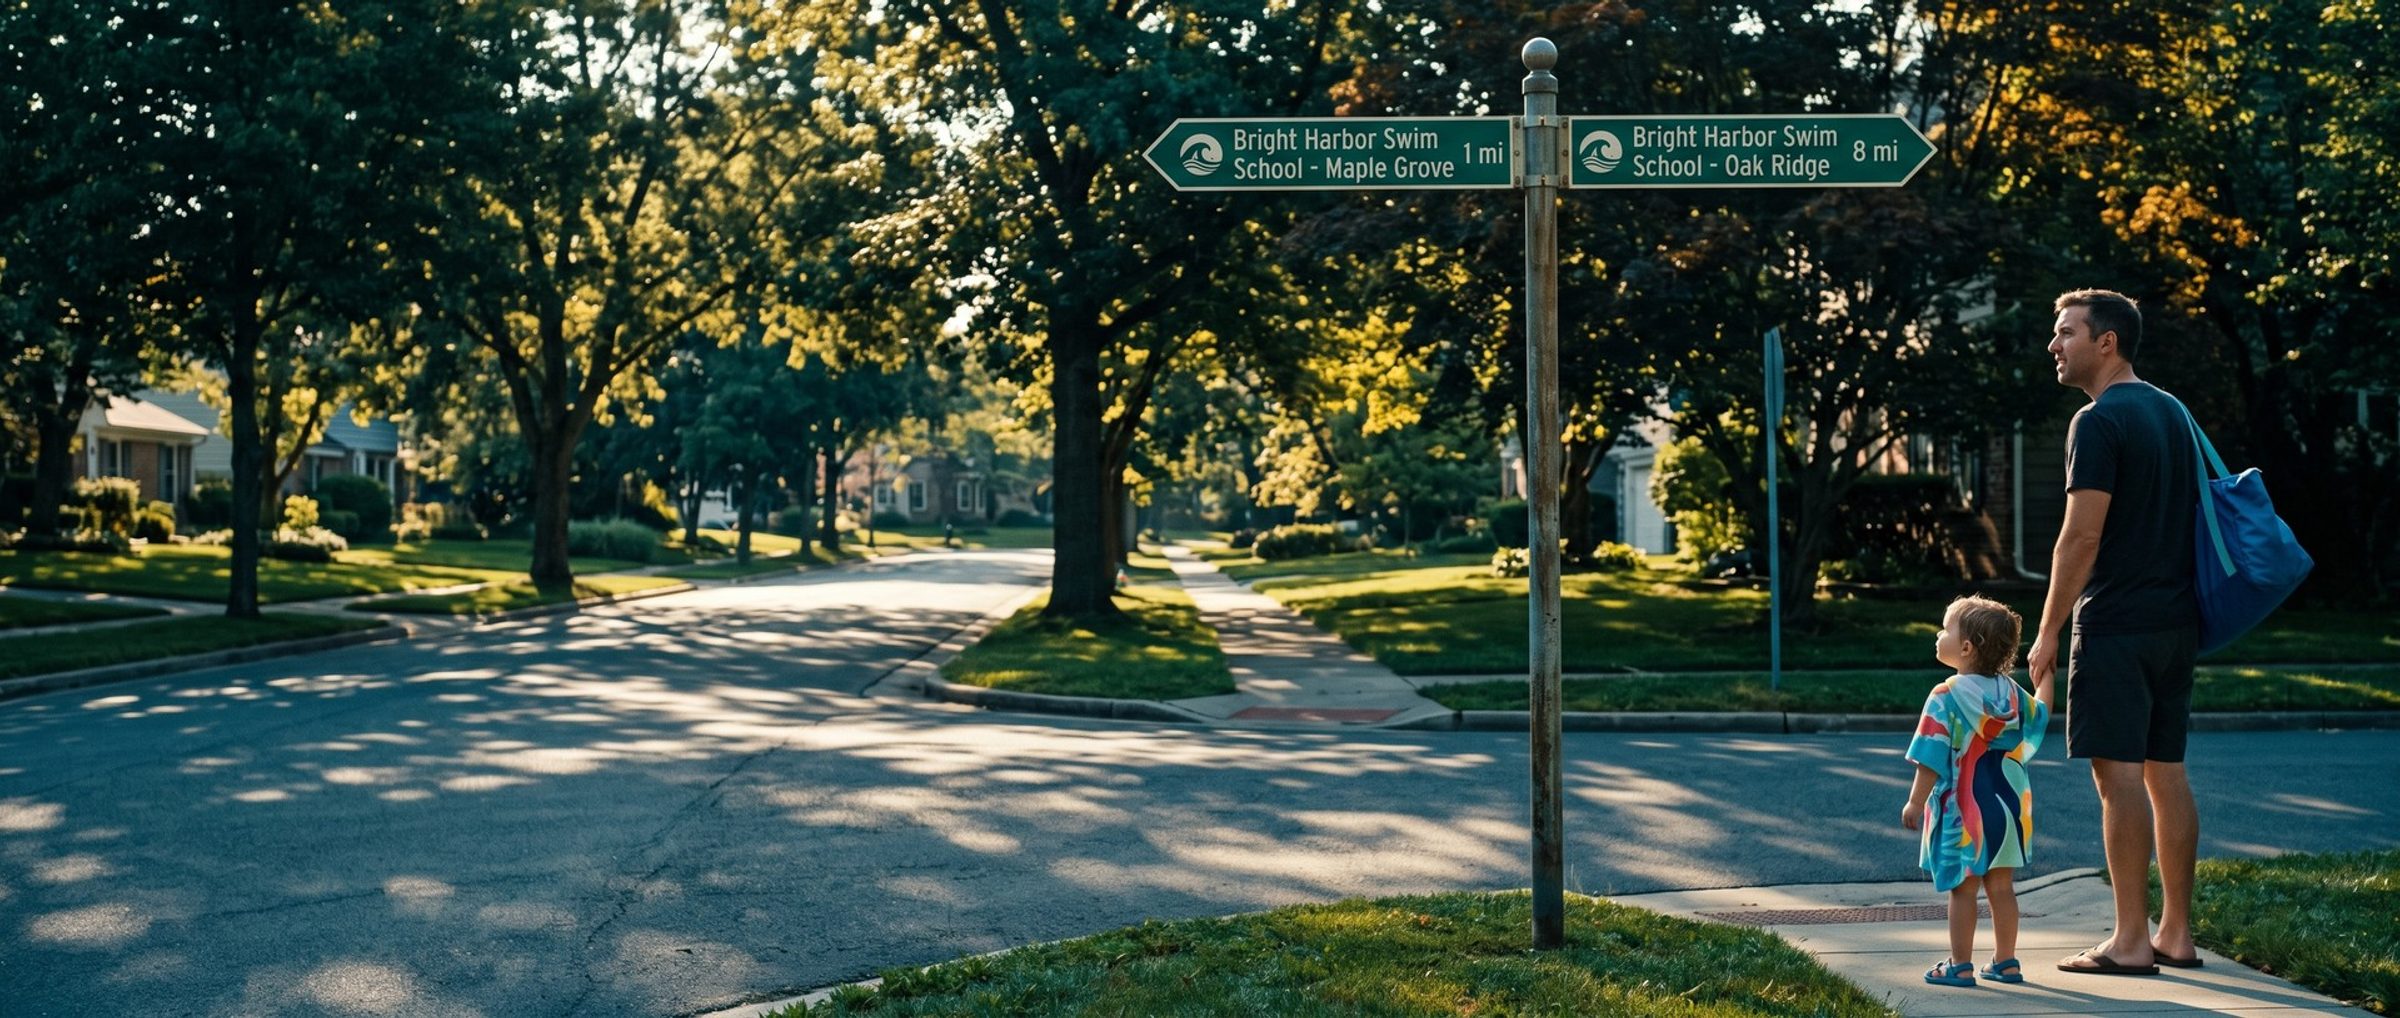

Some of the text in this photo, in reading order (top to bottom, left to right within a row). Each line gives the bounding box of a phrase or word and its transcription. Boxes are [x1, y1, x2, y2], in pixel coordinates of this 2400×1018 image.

[1234, 128, 1438, 156] Bright Harbor Swim
[1633, 125, 1837, 153] Bright Harbor Swim
[1853, 139, 1898, 162] 8 mi
[1463, 142, 1503, 164] 1 mi
[1234, 157, 1303, 180] School
[1326, 157, 1387, 184] Maple
[1394, 157, 1455, 179] Grove
[1633, 154, 1702, 177] School
[1725, 154, 1765, 177] Oak
[1772, 154, 1830, 181] Ridge
